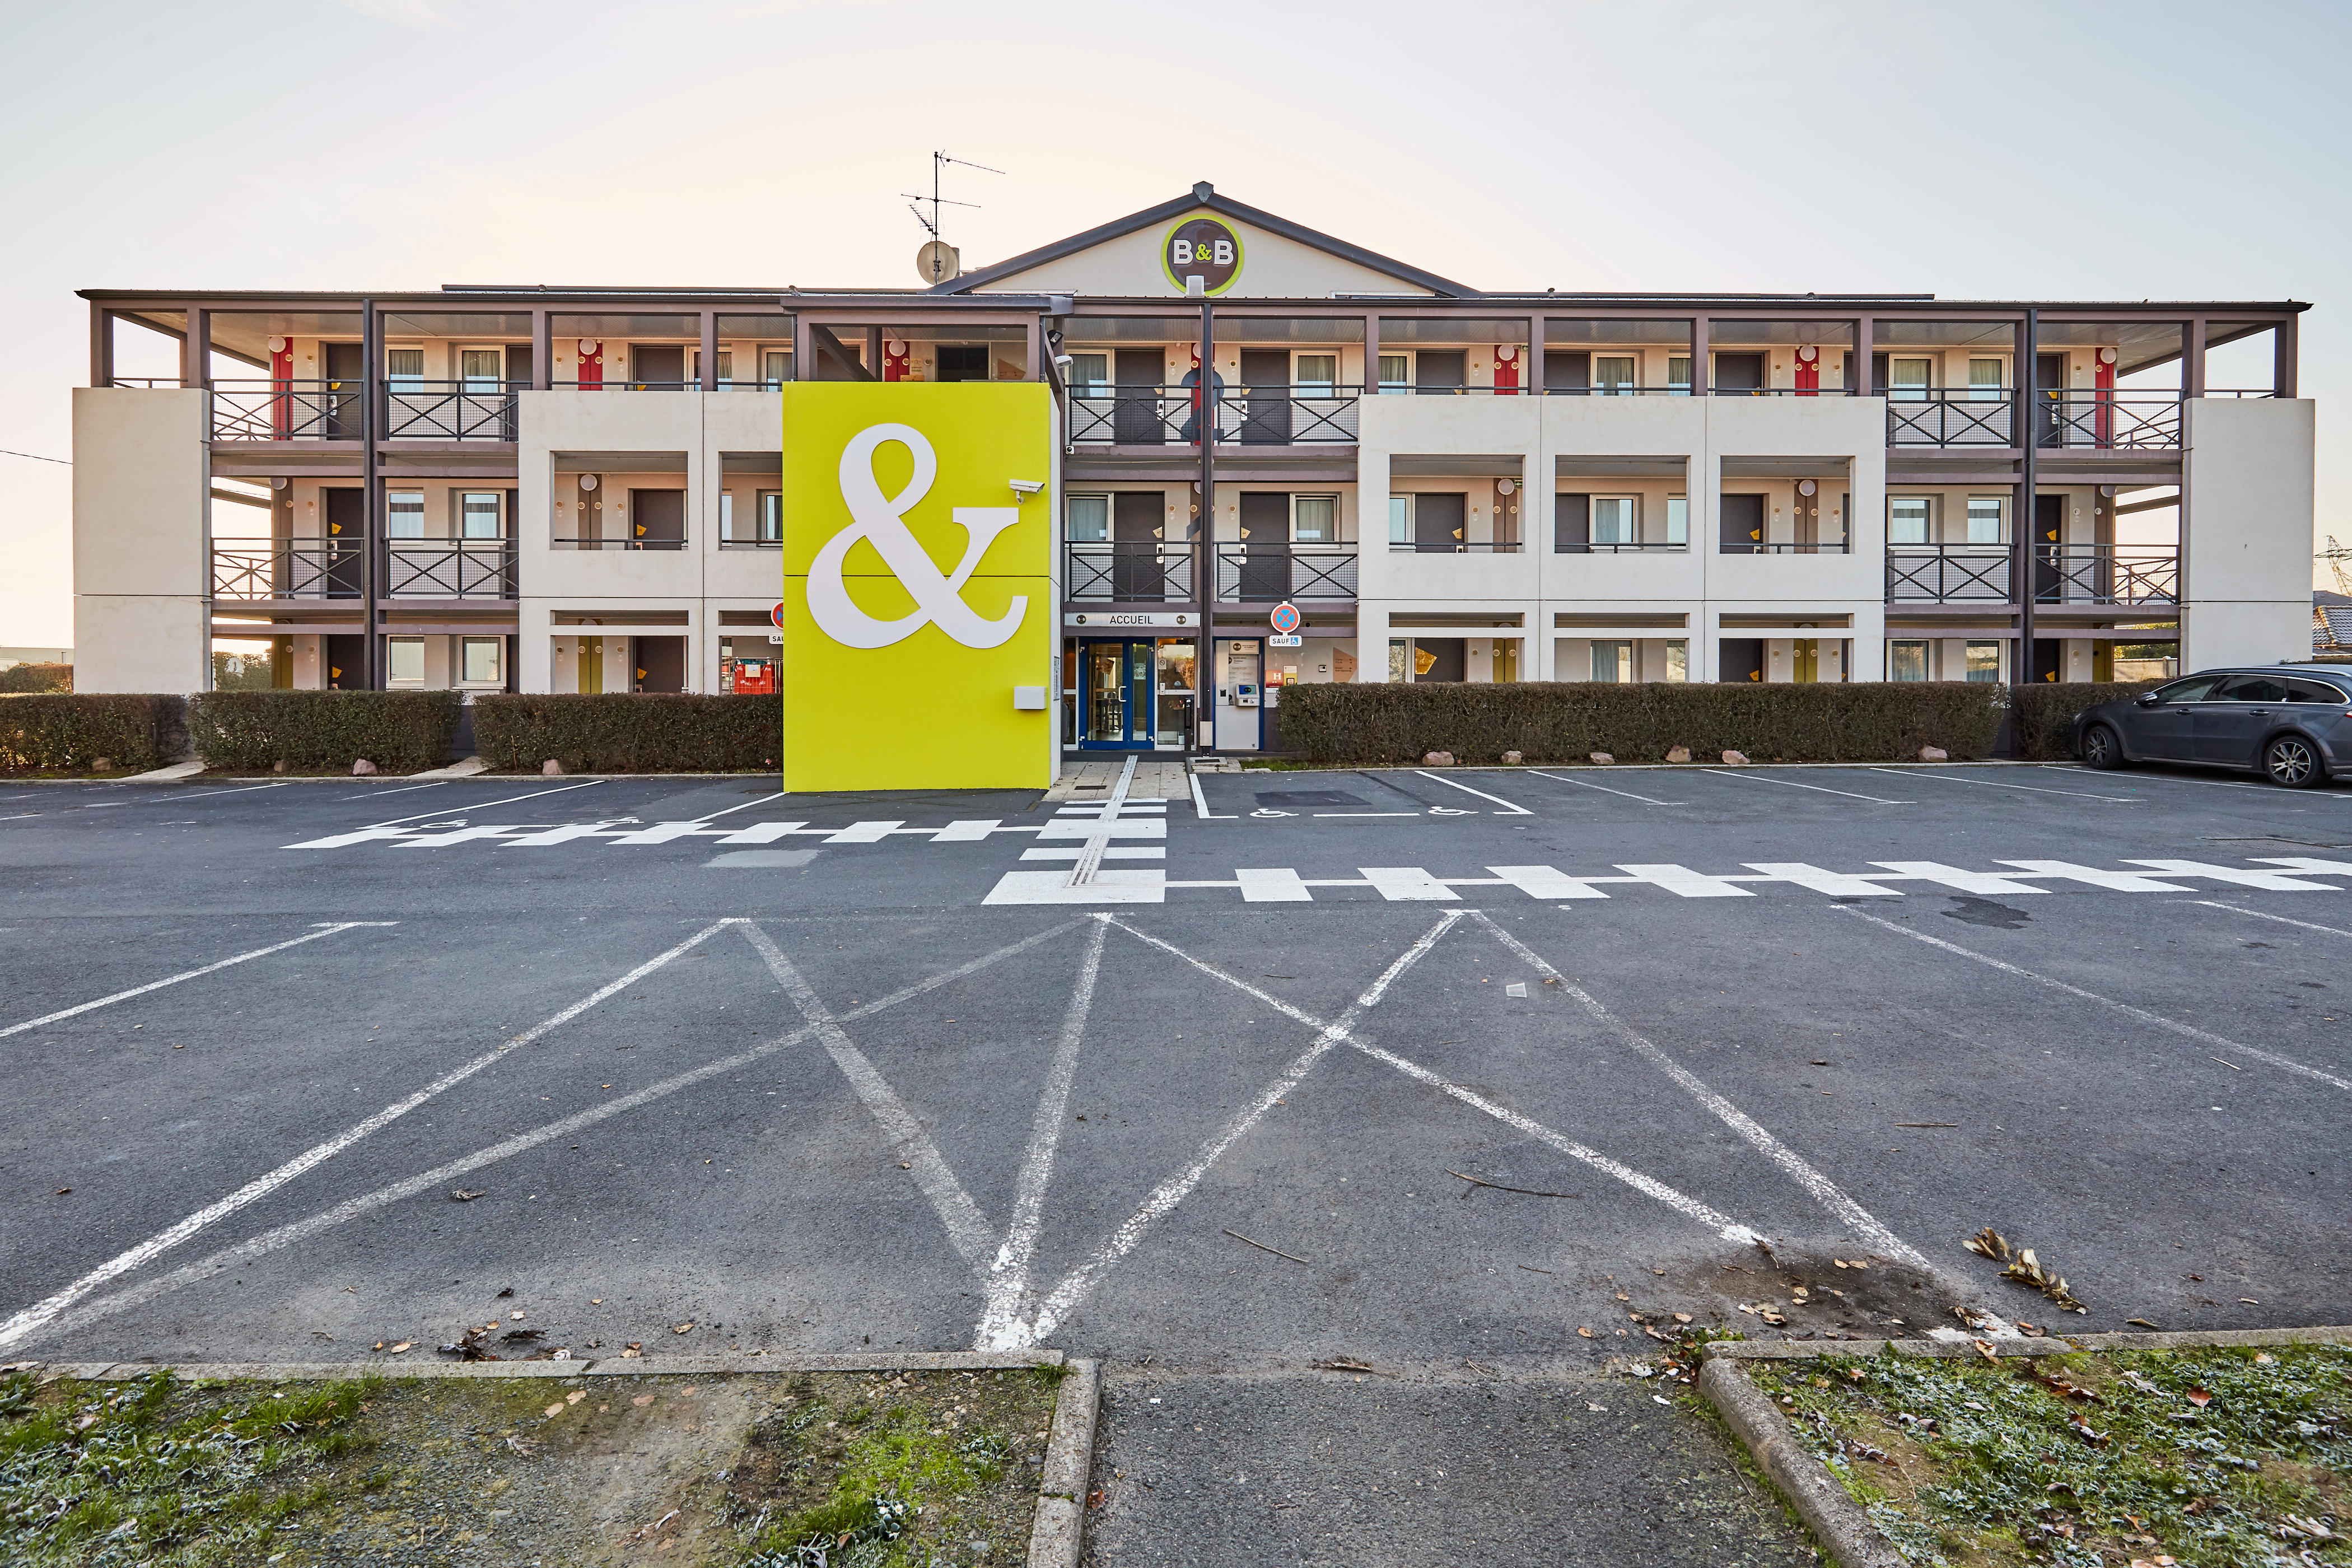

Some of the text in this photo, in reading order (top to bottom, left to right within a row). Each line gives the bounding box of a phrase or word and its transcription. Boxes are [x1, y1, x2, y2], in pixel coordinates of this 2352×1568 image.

[1173, 239, 1234, 265] B&B
[806, 423, 1029, 649] &
[1109, 615, 1154, 624] ACCUEIL
